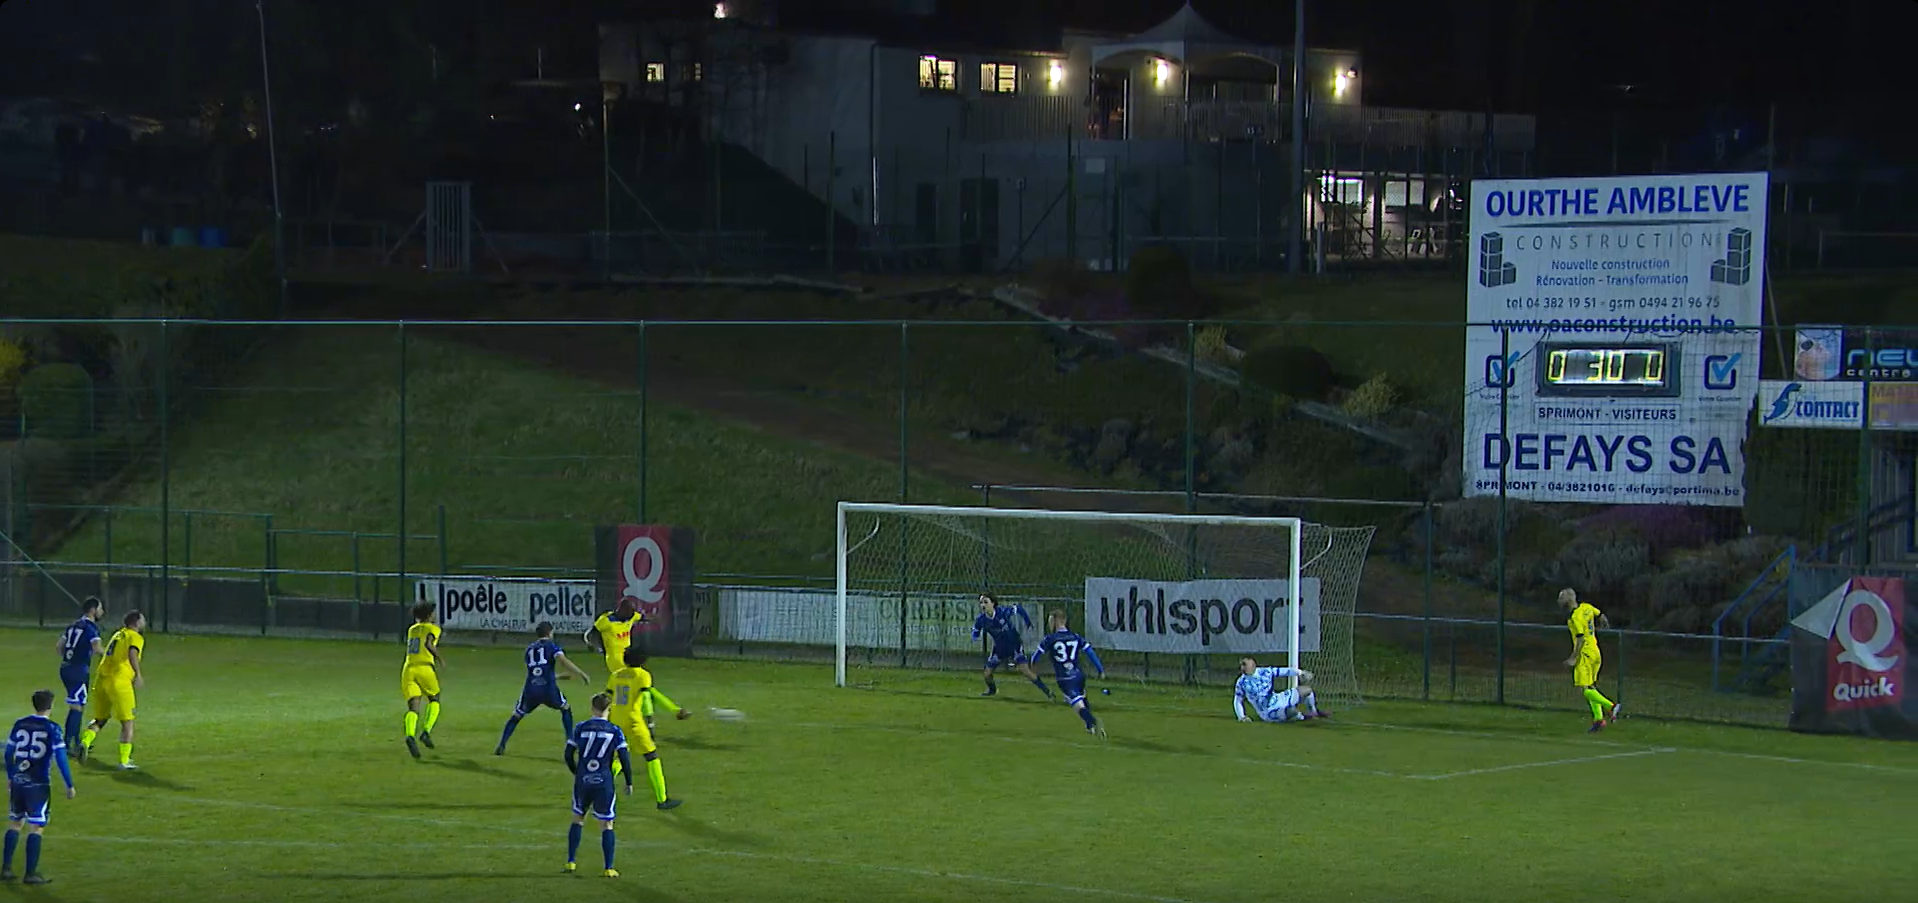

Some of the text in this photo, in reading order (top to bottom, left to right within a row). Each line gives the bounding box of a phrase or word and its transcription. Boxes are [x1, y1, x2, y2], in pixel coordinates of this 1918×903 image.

[1486, 184, 1750, 217] OURTHE AMBLEVE
[1551, 258, 1670, 271] Nouvelle construction
[1536, 274, 1595, 286] Rénovation
[1606, 273, 1689, 285] Transformation
[1506, 297, 1523, 309] tel
[1526, 297, 1540, 309] 04
[1544, 297, 1564, 309] 382
[1568, 297, 1580, 308] 19
[1585, 297, 1597, 308] 51
[1609, 299, 1635, 311] gsm
[1639, 297, 1667, 308] 0494
[1672, 297, 1683, 308] 21
[1688, 297, 1702, 308] 96
[1491, 313, 1736, 335] www.oaconstruction.be
[1538, 407, 1601, 420] SPRIMONT
[1612, 408, 1677, 420] VISITEURS
[1796, 401, 1860, 418] CONTACT
[1483, 433, 1732, 474] DEFAYS SA
[1476, 480, 1538, 491] SPRMONT
[447, 583, 593, 623] poêle pellet
[65, 627, 84, 649] 17
[527, 647, 548, 668] 11
[1053, 640, 1080, 662] 37
[1833, 676, 1895, 702] Quick
[15, 728, 49, 758] 25
[580, 731, 615, 758] 77
